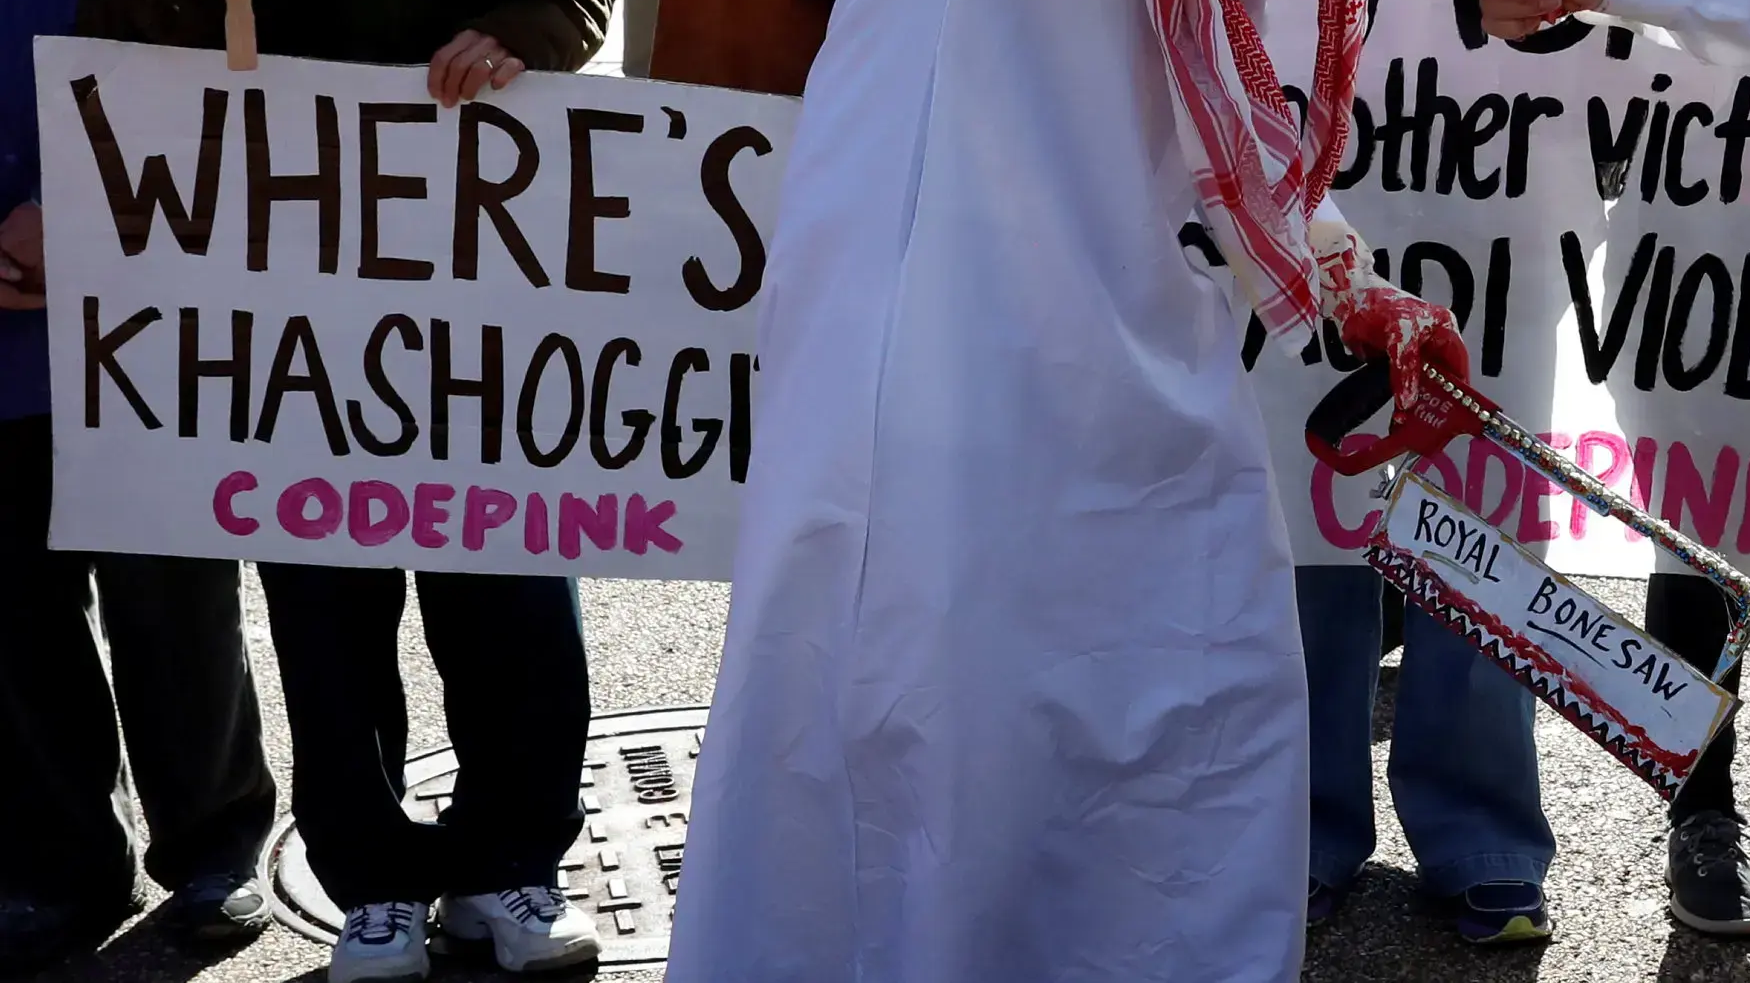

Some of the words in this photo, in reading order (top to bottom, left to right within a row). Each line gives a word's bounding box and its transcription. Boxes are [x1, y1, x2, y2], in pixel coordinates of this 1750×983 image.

[70, 75, 773, 311] WHERE'S
[212, 471, 684, 559] CODEPINK
[1415, 498, 1502, 583] ROYAL
